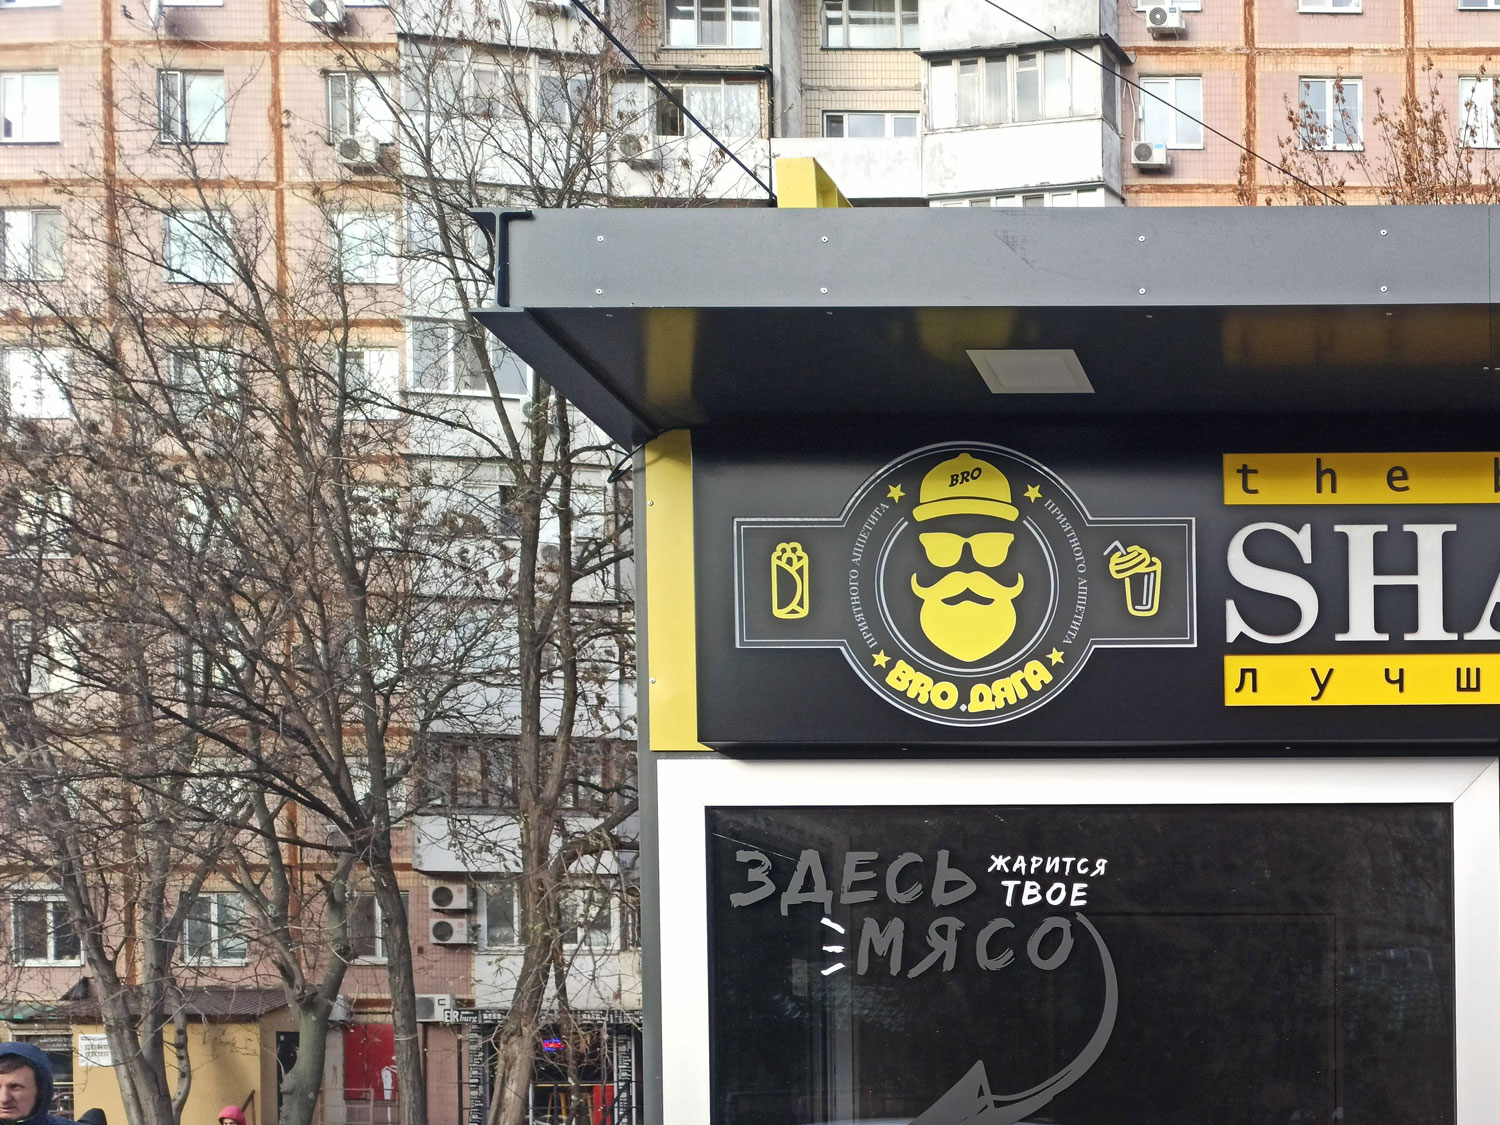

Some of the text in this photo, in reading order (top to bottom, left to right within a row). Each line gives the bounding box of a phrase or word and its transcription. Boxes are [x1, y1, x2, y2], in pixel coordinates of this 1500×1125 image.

[948, 467, 982, 488] BRO
[1236, 457, 1411, 494] the
[849, 502, 890, 649] ПРИЯТНОГО АППЕТИТА
[1044, 499, 1088, 645] ПРИЯТНОГО АППЕТИТА
[730, 849, 976, 916] ЗДЕСЬ
[988, 855, 1107, 876] ЖАРИТСЯ
[1002, 881, 1087, 906] ТВОЕ
[857, 916, 1074, 978] МЯСО
